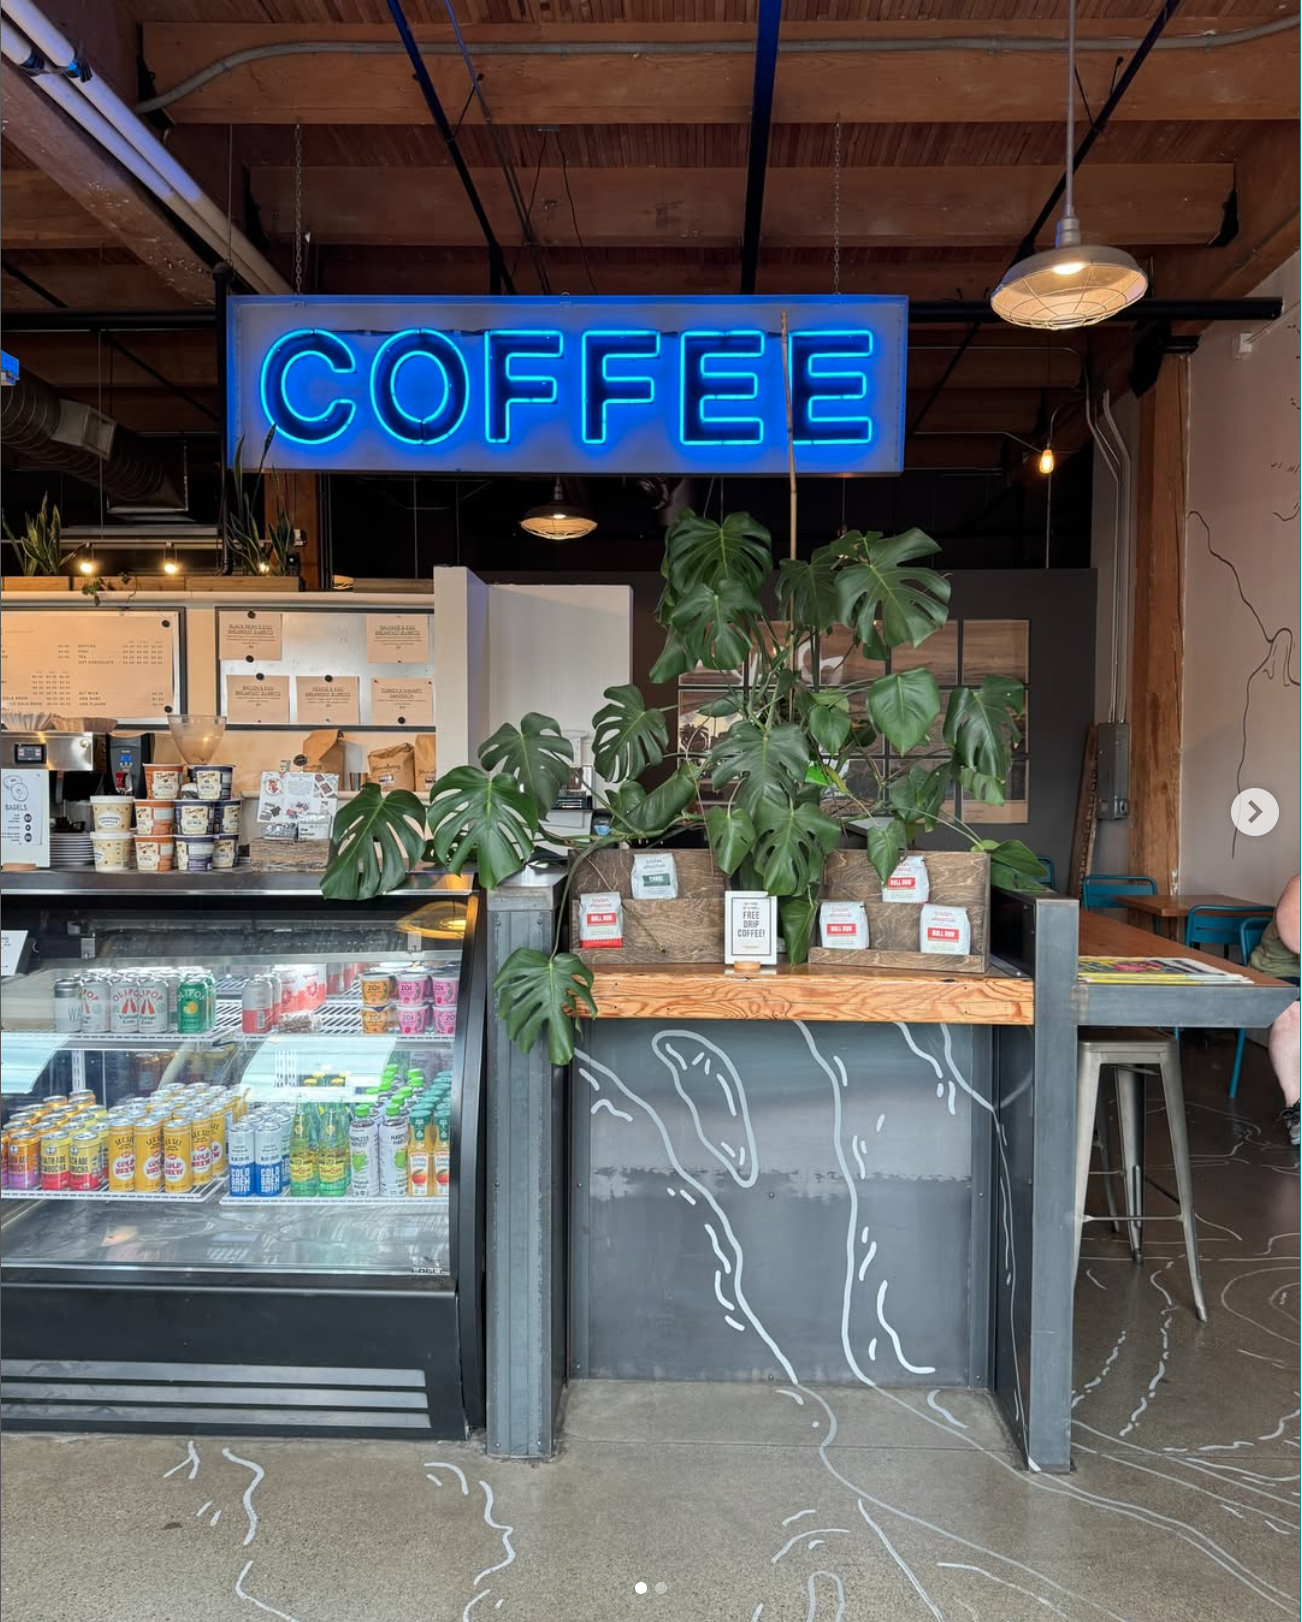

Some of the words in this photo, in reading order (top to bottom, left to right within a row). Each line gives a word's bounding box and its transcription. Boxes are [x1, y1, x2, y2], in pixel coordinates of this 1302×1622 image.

[259, 329, 875, 446] COFFEE
[743, 911, 760, 919] FREE
[743, 920, 759, 928] DRIP
[232, 1168, 250, 1177] COLD
[261, 1166, 279, 1176] COLD
[232, 1177, 250, 1185] BREW
[261, 1176, 279, 1185] BREW
